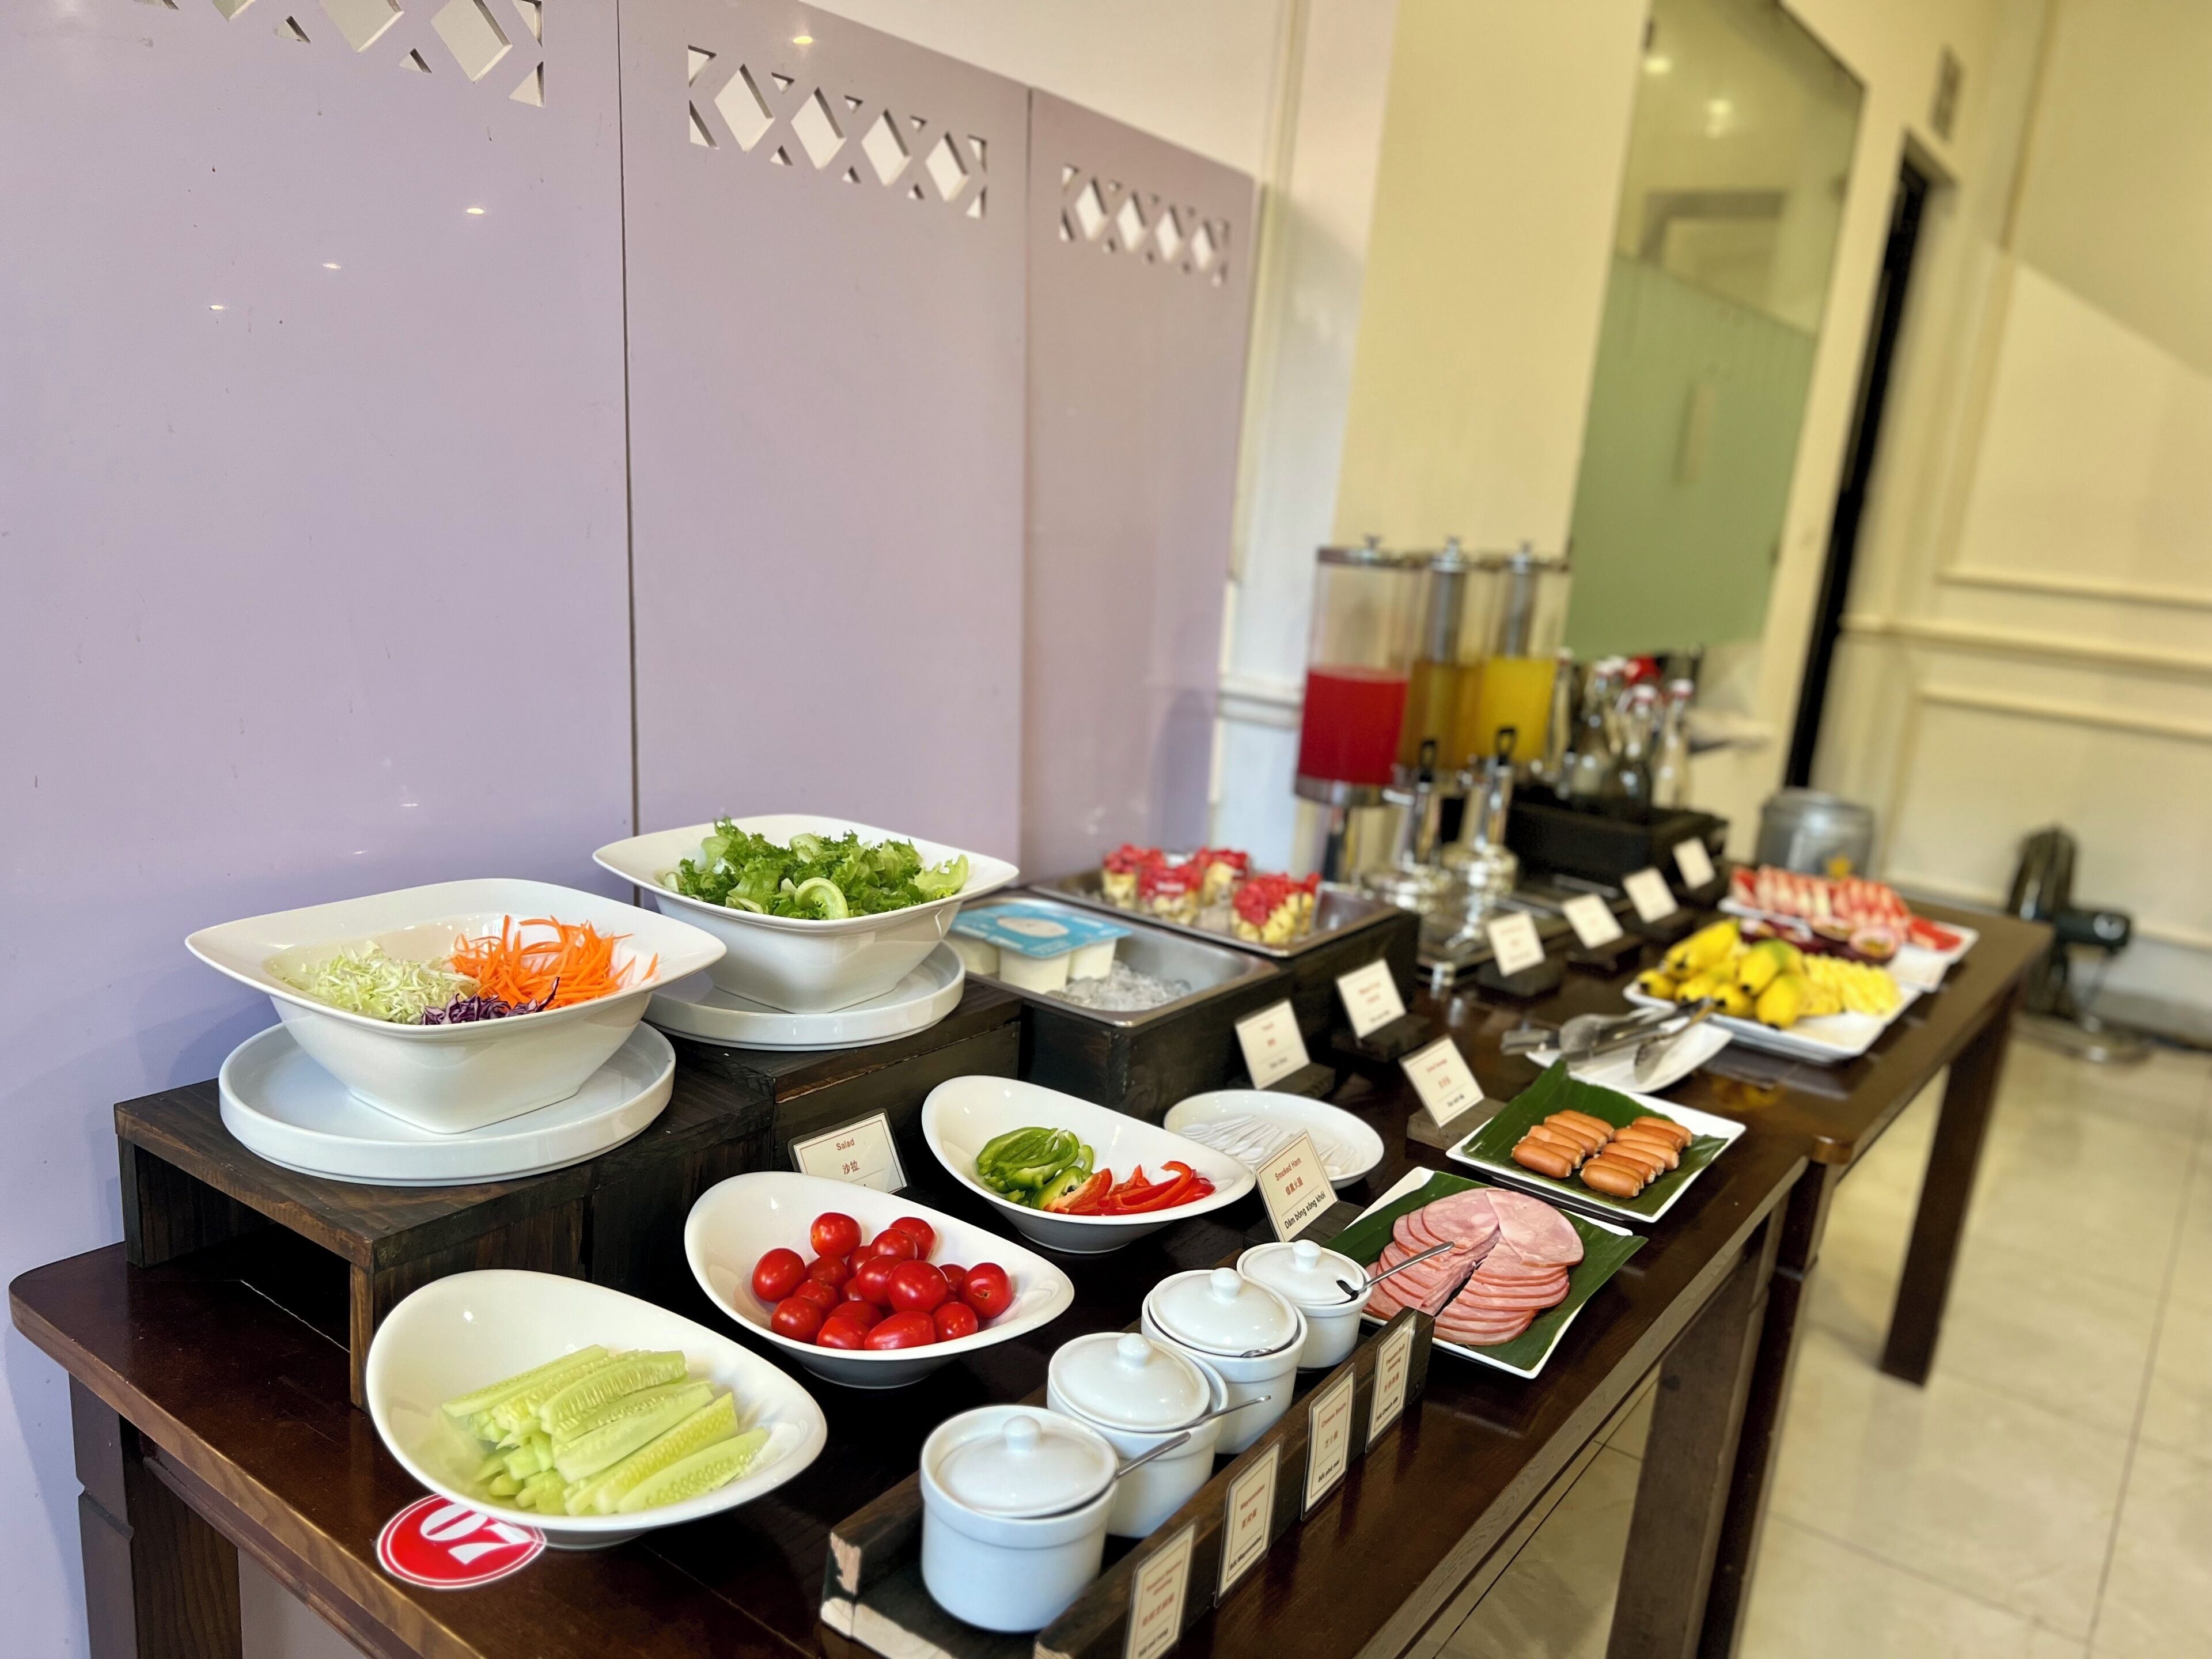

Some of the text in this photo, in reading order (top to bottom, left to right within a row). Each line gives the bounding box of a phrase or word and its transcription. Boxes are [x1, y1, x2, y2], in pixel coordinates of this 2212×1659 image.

[836, 1138, 855, 1151] Salad
[842, 1160, 860, 1175] 沙拉
[1275, 1158, 1302, 1181] Smoked Ham
[1316, 1191, 1326, 1204] khói
